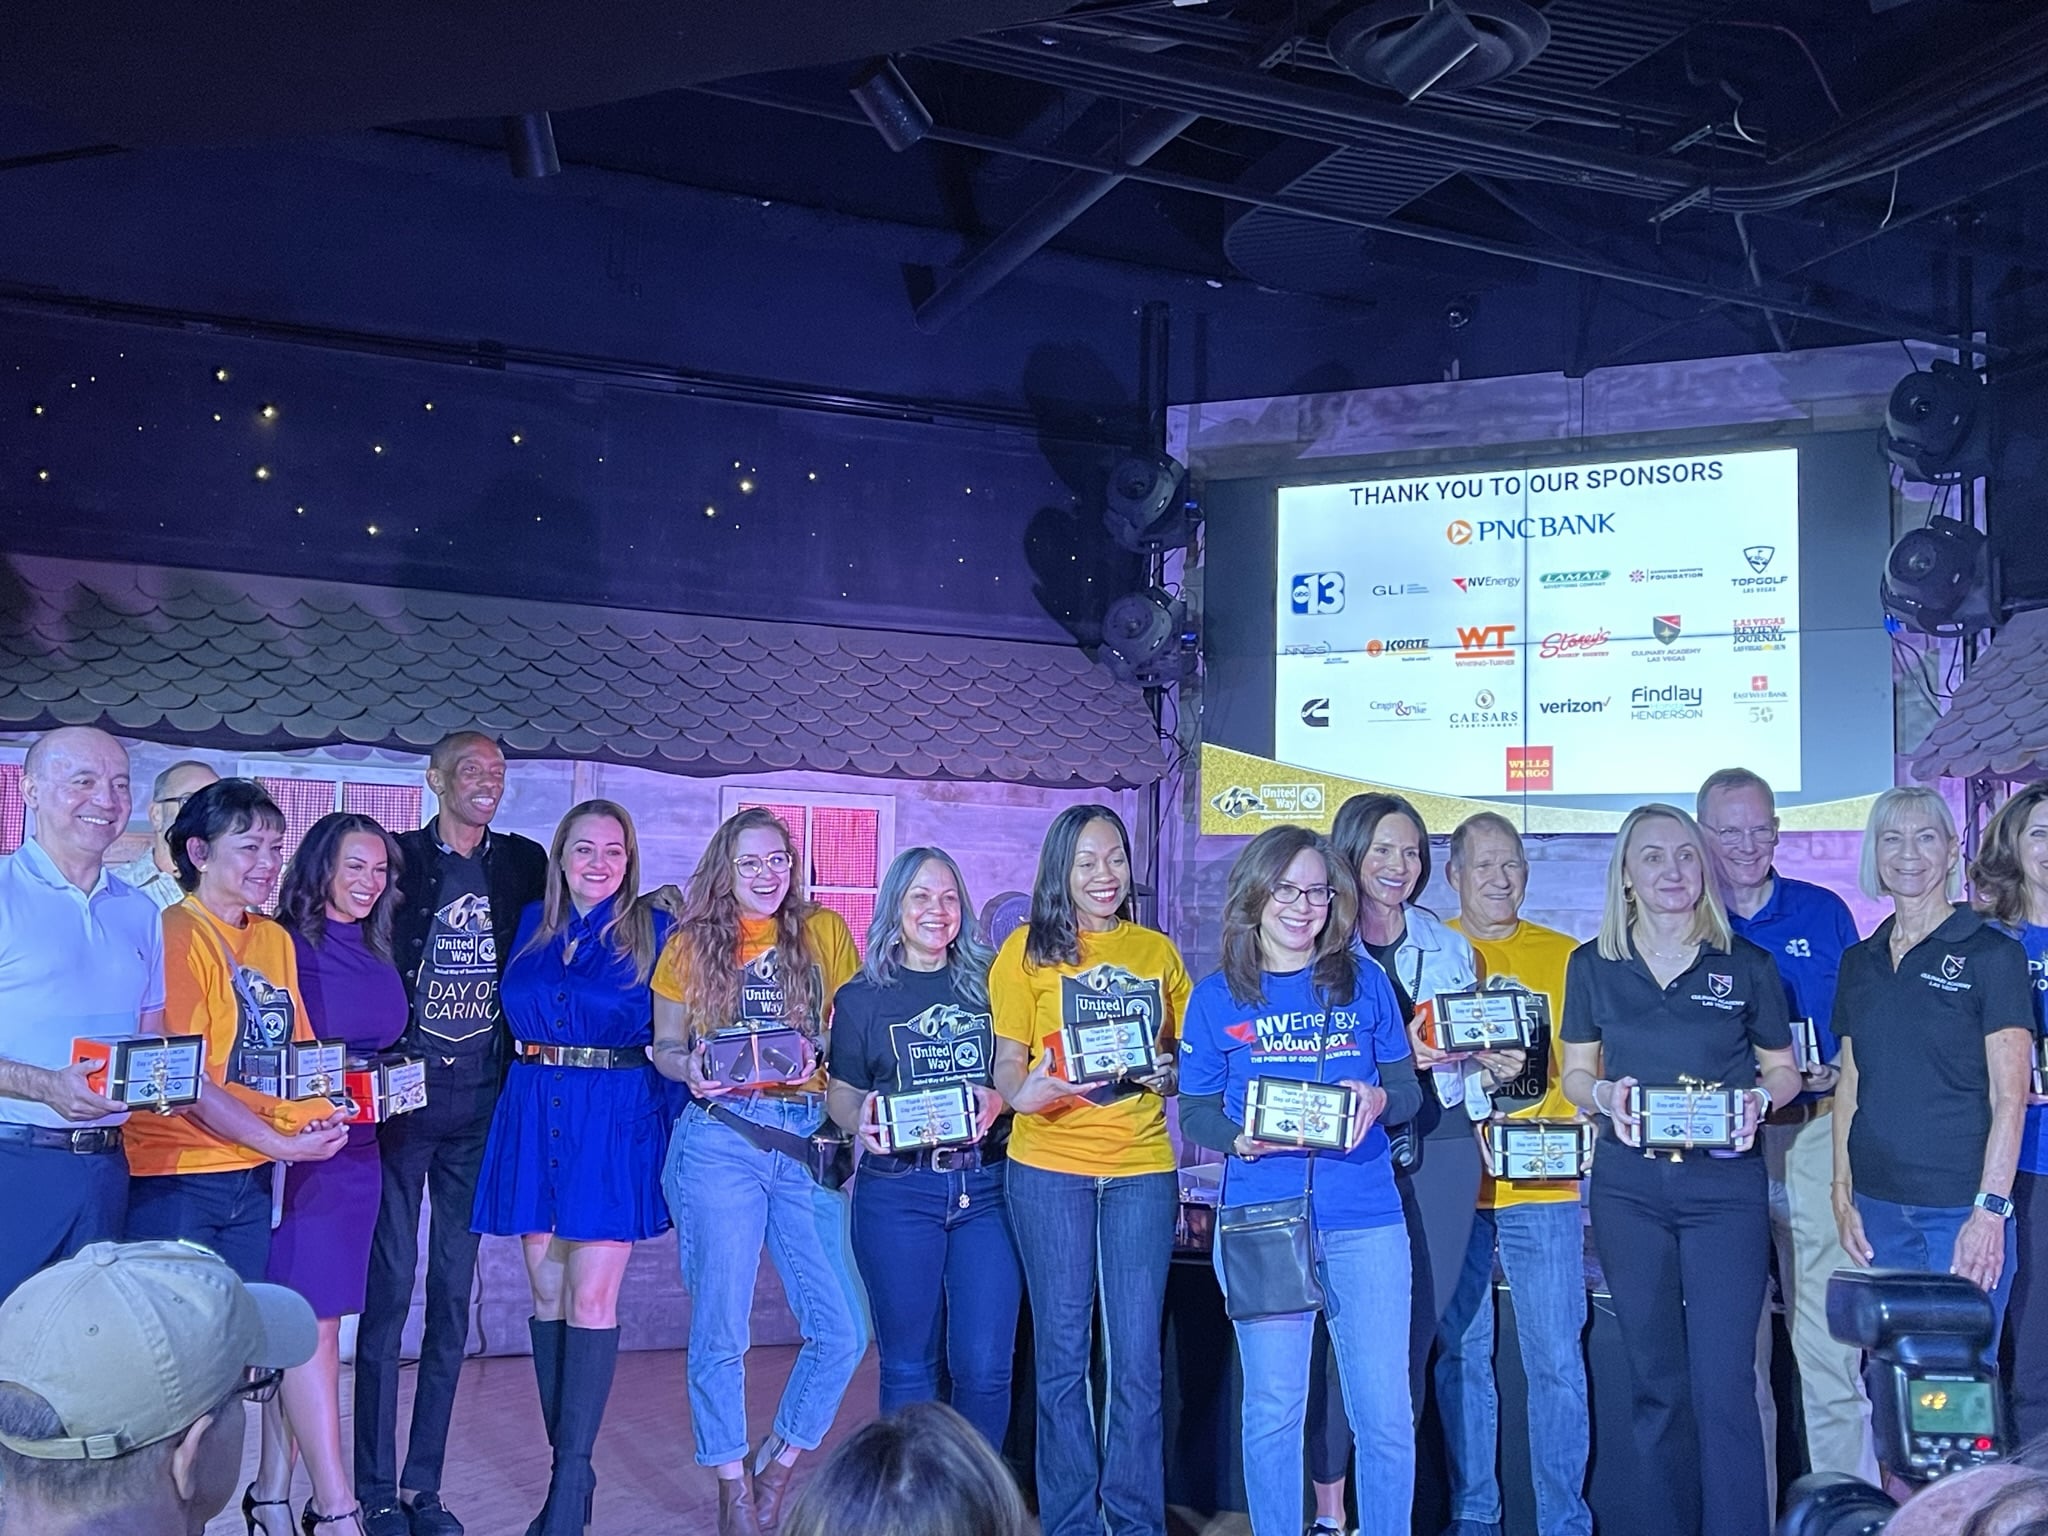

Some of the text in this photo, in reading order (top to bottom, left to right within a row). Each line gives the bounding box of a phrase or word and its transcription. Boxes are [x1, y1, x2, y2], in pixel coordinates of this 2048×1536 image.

[1350, 461, 1723, 505] THANK YOU TO OUR SPONSORS
[1468, 576, 1521, 589] NVEnergy
[1545, 570, 1604, 583] LAMAR
[1650, 573, 1703, 581] FOUNDATION
[1731, 576, 1788, 586] TOPGOLF
[1303, 572, 1345, 614] 13
[1372, 585, 1404, 597] GLI
[1733, 617, 1786, 626] LAS VEGAS
[1456, 625, 1516, 650] WT
[1733, 633, 1786, 645] JOURNAL
[1385, 639, 1429, 652] KORTE
[1631, 648, 1702, 657] CULINARY ACADEMY
[1632, 685, 1702, 706] Findlay
[1540, 699, 1602, 714] verizon
[1450, 712, 1519, 723] CAESARS
[1631, 709, 1703, 720] HENDERSON
[1508, 760, 1550, 769] WELLS
[1510, 769, 1549, 778] FARGO
[1263, 788, 1297, 798] United
[1275, 799, 1297, 810] Way
[437, 938, 474, 950] United
[451, 950, 474, 964] Way
[428, 980, 498, 1000] DAY OF
[761, 1001, 784, 1016] Way
[1080, 998, 1120, 1011] United
[912, 1044, 950, 1059] United
[927, 1058, 951, 1072] Way
